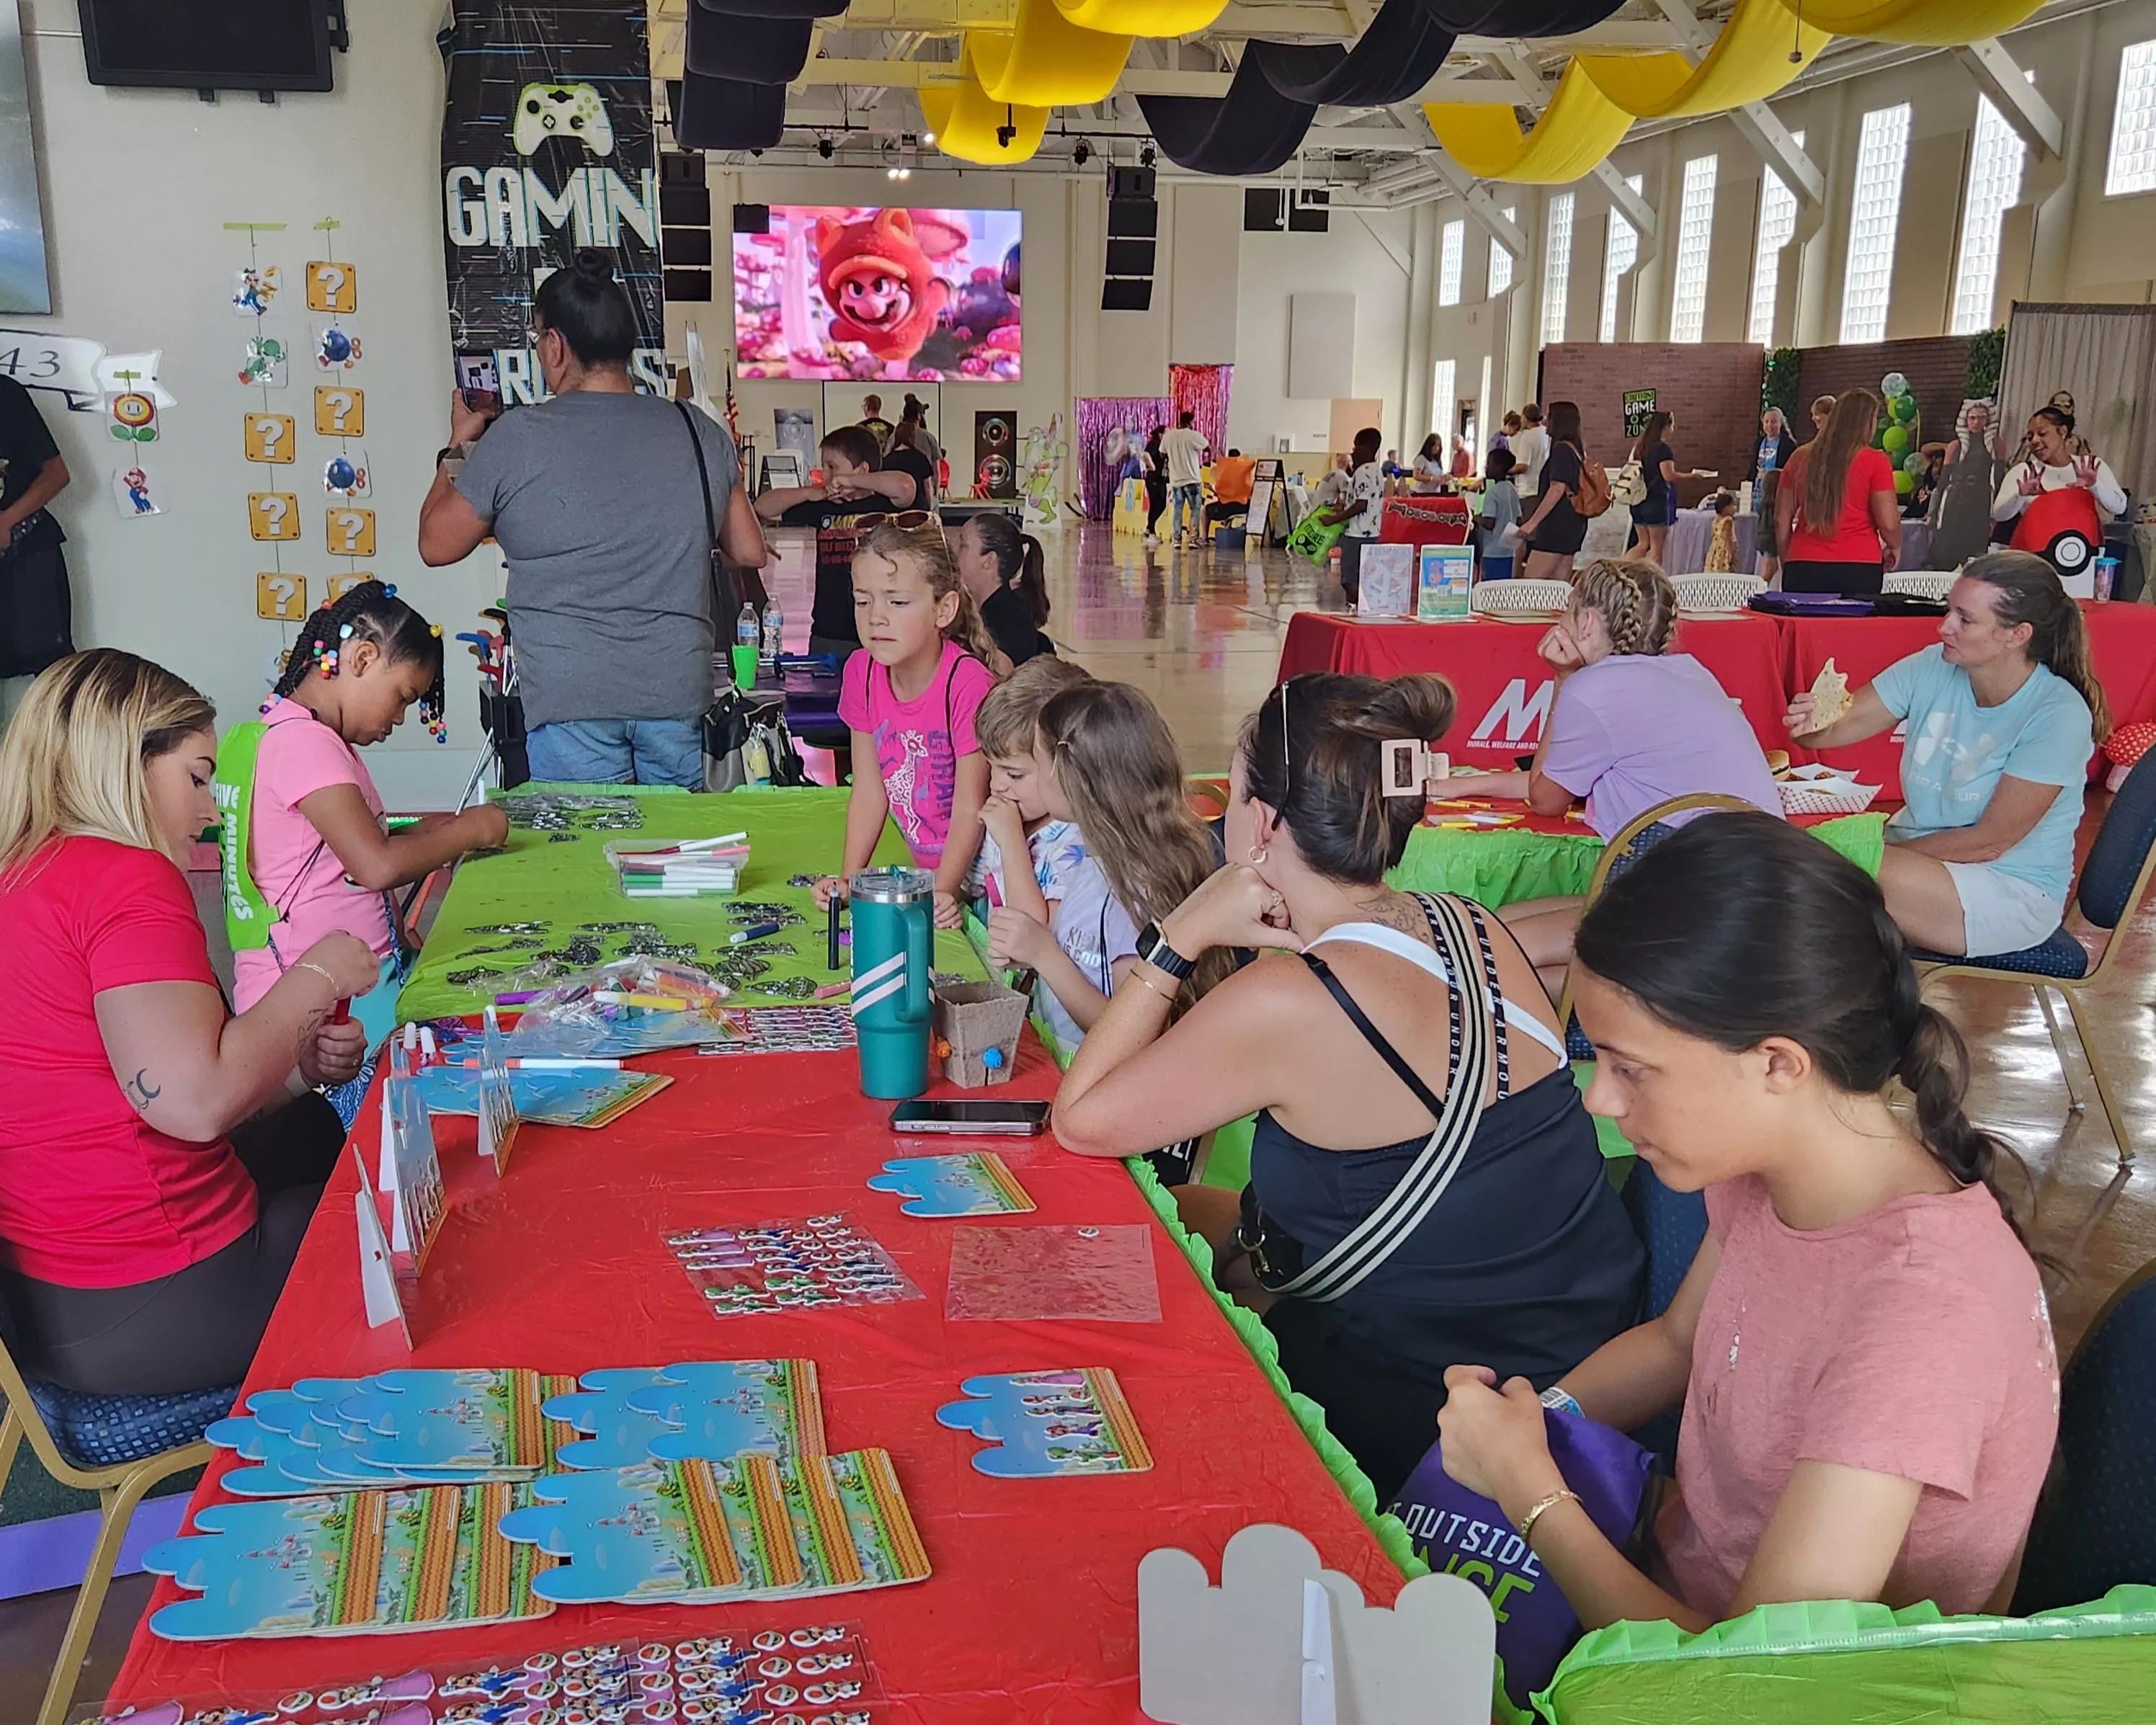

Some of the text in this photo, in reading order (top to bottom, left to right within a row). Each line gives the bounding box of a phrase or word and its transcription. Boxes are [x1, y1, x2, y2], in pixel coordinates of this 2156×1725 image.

[446, 166, 657, 247] GAMIN
[1625, 399, 1655, 416] GAME
[1304, 523, 1325, 545] MORE
[1466, 740, 1490, 749] MORALE,
[1491, 741, 1516, 749] WELFARE
[227, 812, 254, 919] MINUTES
[1435, 934, 1458, 1002] ARMOUR
[1449, 1012, 1460, 1075] UNDER
[1479, 937, 1502, 1006] UNDER
[1404, 1503, 1541, 1578] OUTSIDE
